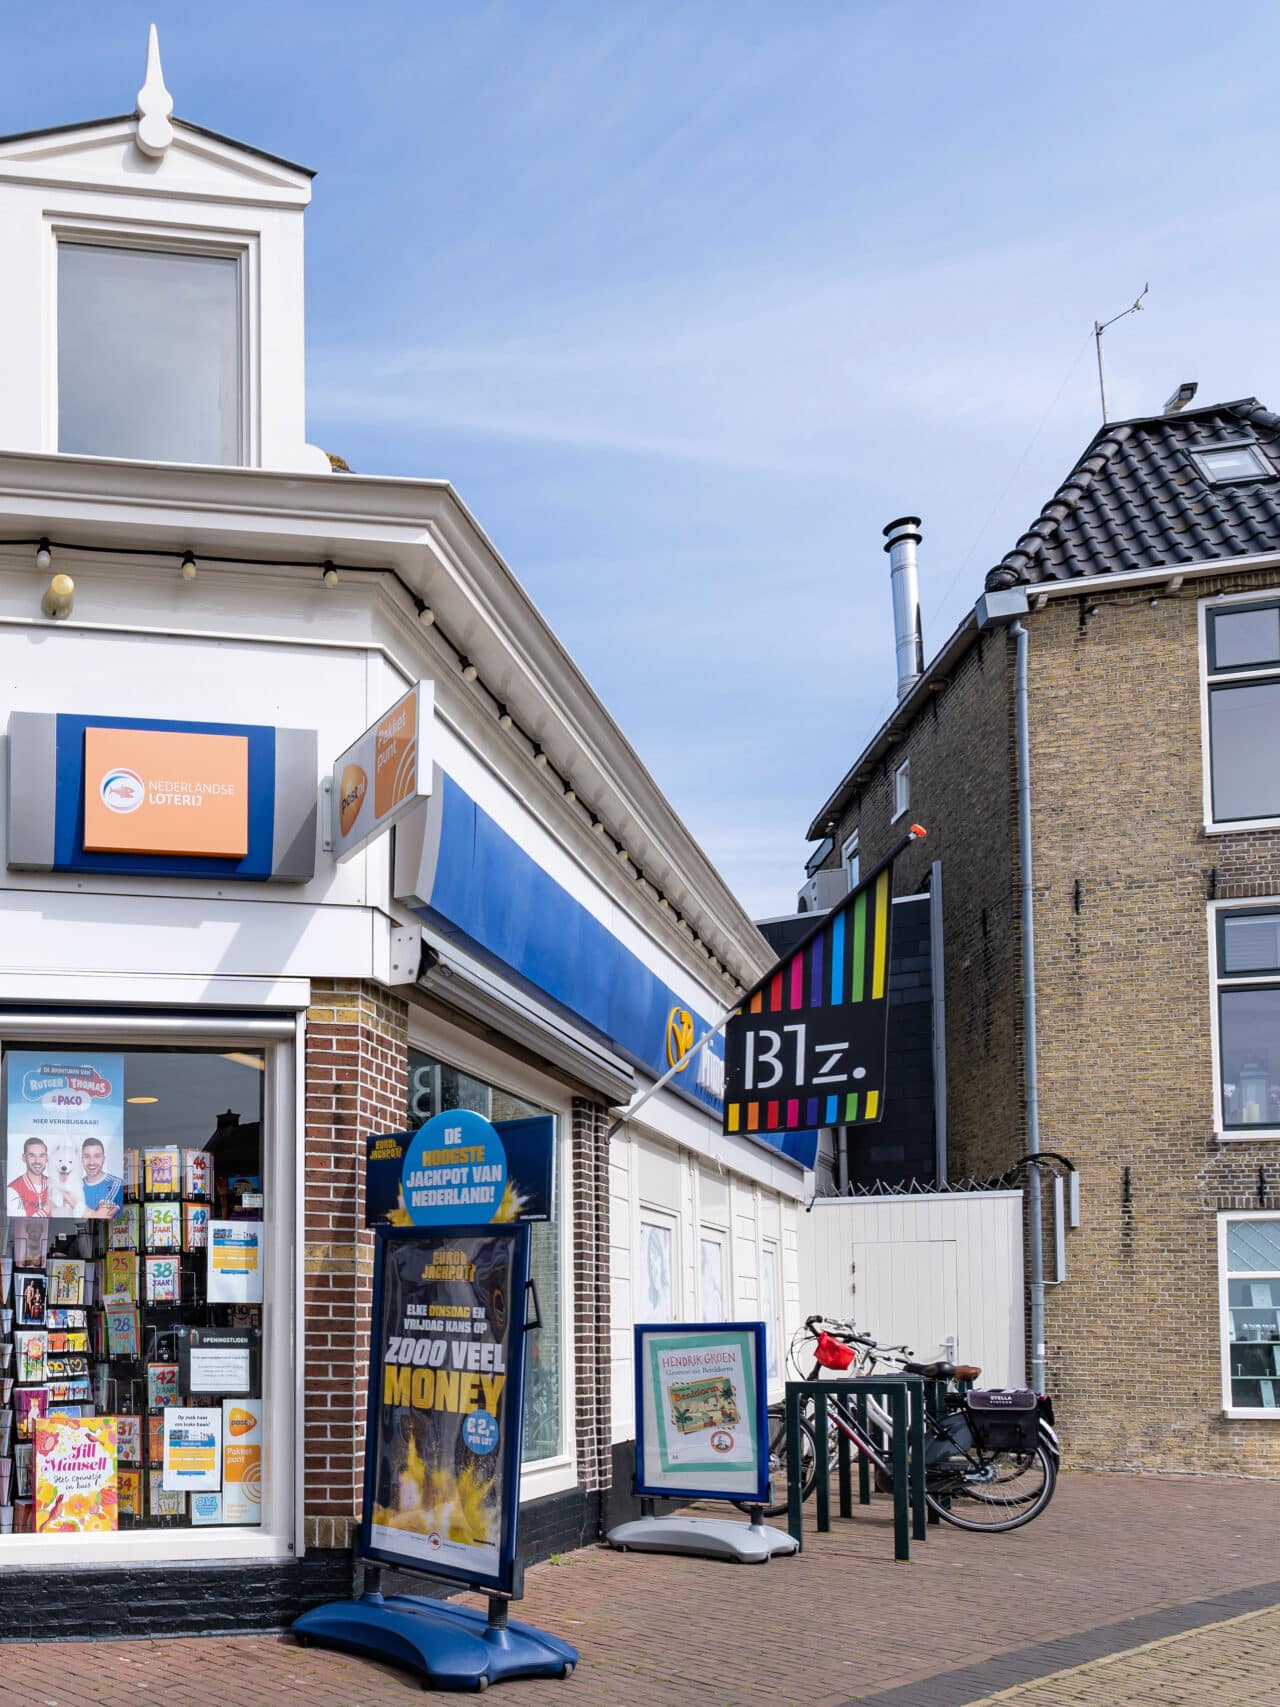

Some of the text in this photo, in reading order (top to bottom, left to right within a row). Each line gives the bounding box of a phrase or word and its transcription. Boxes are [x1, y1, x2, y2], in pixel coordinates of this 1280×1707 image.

[378, 711, 407, 747] Pakket
[377, 740, 397, 774] punt
[148, 781, 235, 796] NEDERLANDSE
[341, 776, 365, 815] postnl
[148, 793, 203, 807] LOTERIJ
[70, 1079, 106, 1093] THOMAS
[57, 1095, 82, 1106] PACO
[444, 1127, 462, 1145] DE
[193, 1156, 207, 1170] 46
[422, 1145, 485, 1168] HOOGSTE
[406, 1164, 503, 1188] JACKPOT VAN
[411, 1186, 495, 1207] NEDERLAND!
[153, 1209, 173, 1225] 36
[193, 1210, 207, 1225] 49
[112, 1257, 129, 1272] 25
[152, 1262, 173, 1278] 38
[406, 1303, 486, 1319] ELKE DINSDAG EN
[113, 1317, 131, 1332] 28
[403, 1318, 488, 1335] VRIJDAG KANS OP
[384, 1336, 506, 1373] ZOOO VEEL
[662, 1352, 736, 1368] HENDRIK GROEN
[156, 1369, 176, 1385] 42
[383, 1365, 507, 1418] MONEY
[672, 1385, 720, 1402] Benidorm
[70, 1443, 97, 1459] Jill
[42, 1457, 107, 1472] Mansell
